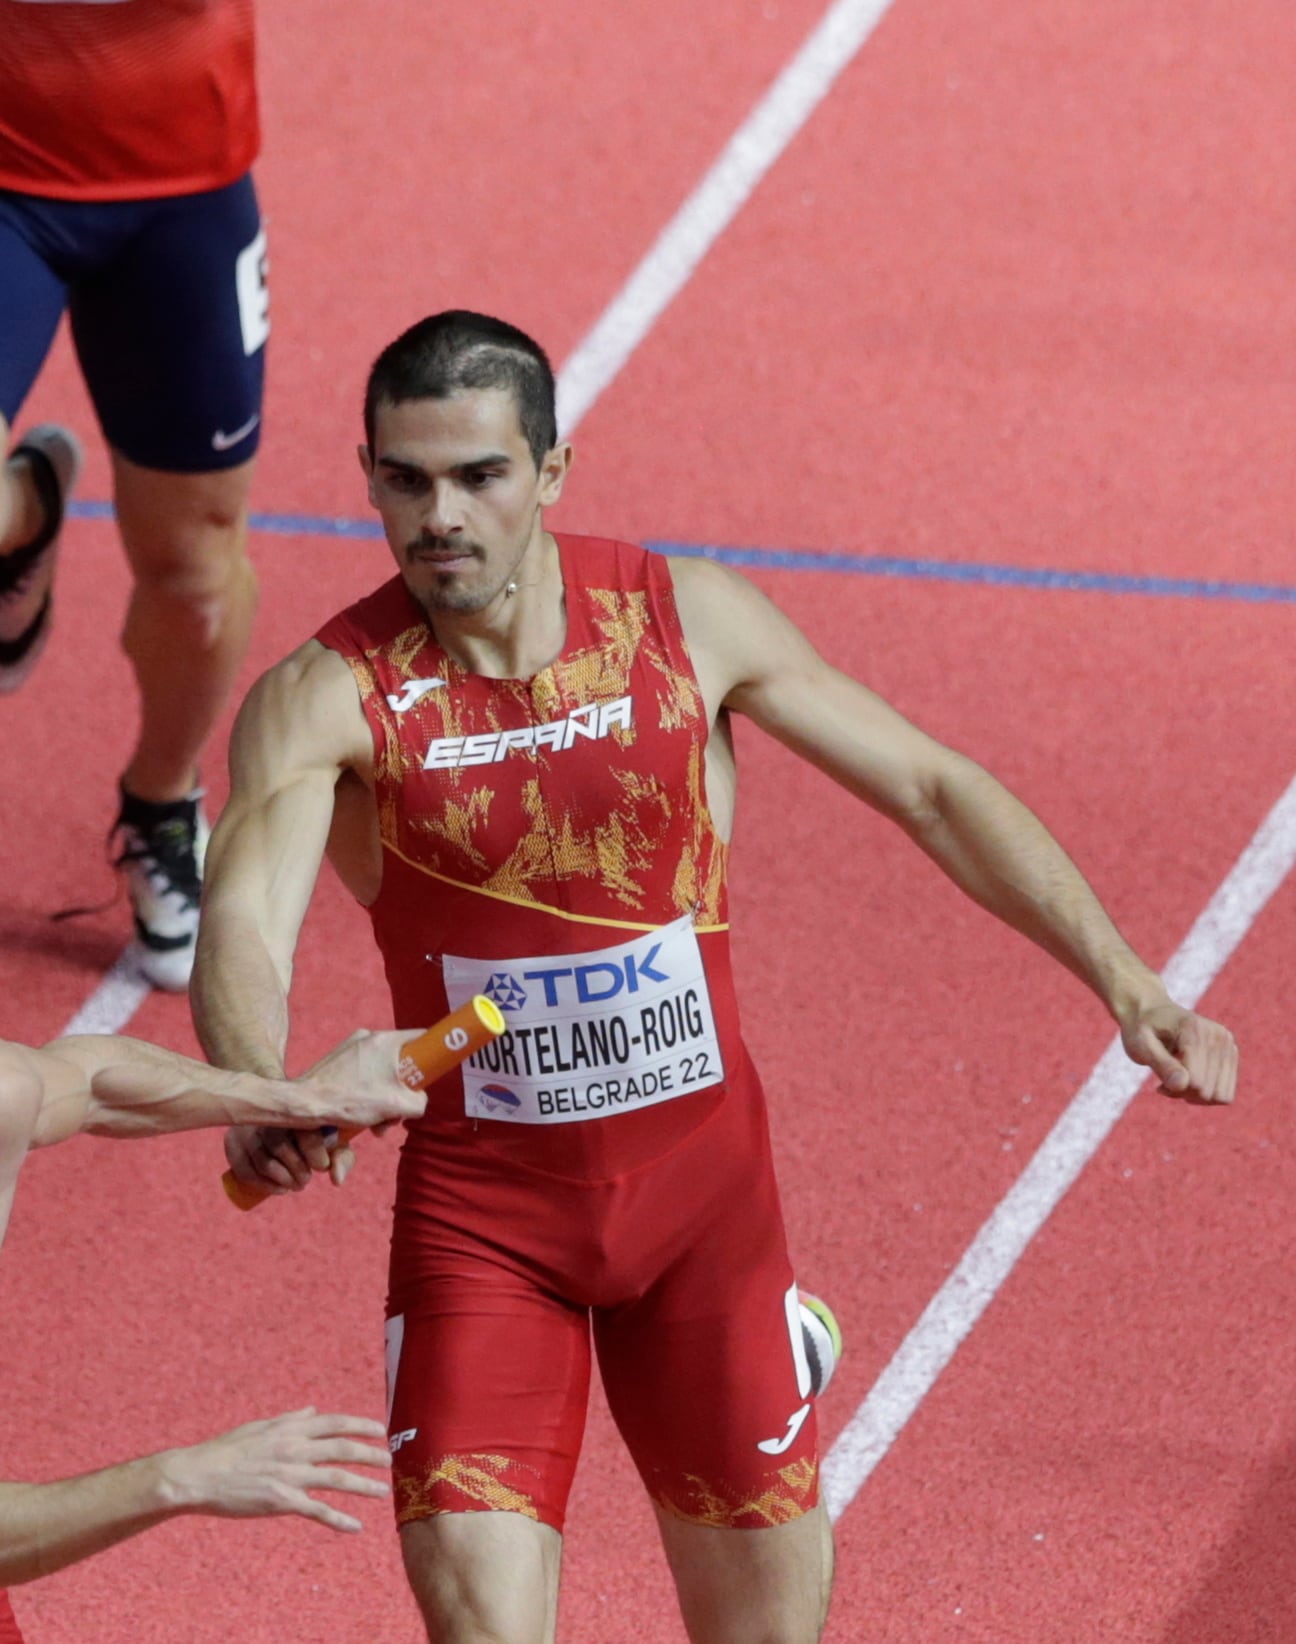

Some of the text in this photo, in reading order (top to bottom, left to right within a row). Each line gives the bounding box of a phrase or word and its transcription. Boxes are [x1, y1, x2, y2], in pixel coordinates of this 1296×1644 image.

[423, 695, 633, 770] ESPAÑA
[524, 942, 671, 1007] TDK
[537, 1052, 713, 1116] BELGRADE 22
